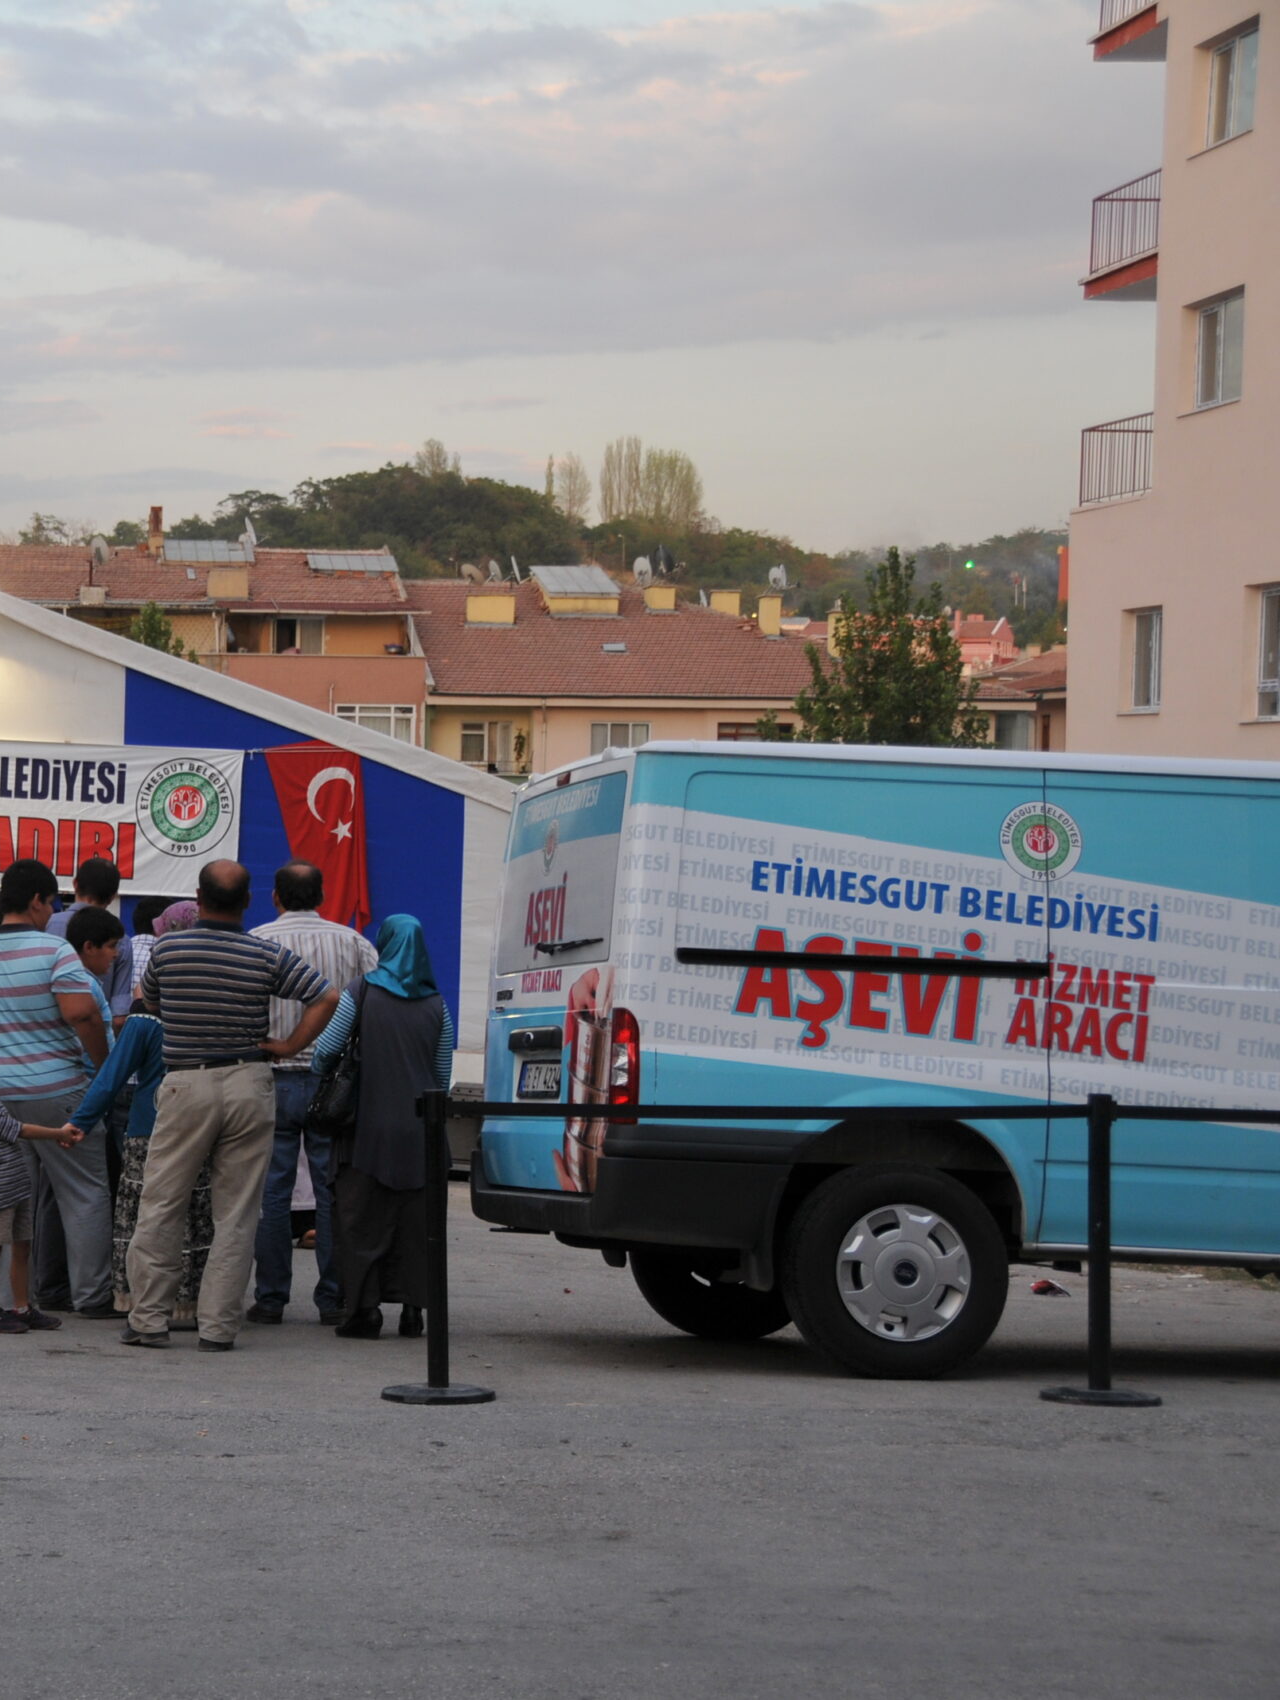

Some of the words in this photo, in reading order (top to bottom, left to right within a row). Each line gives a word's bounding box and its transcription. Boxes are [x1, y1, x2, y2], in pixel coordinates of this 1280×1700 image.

[170, 844, 197, 854] 1990
[672, 826, 776, 857] BELEDİYESİ
[791, 842, 894, 874] ETİMESGUT
[898, 857, 1004, 888] BELEDİYESİ
[666, 891, 770, 922] BELEDİYESİ
[785, 906, 889, 938] ETİMESGUT
[751, 857, 951, 915] ETİMESGUT
[958, 886, 1160, 943] BELEDİYESİ
[731, 924, 987, 1050] AŞEVİ
[653, 1020, 758, 1049] BELEDİYESİ
[879, 1050, 984, 1081] BELEDİYESİ
[1005, 997, 1150, 1063] ARACI
